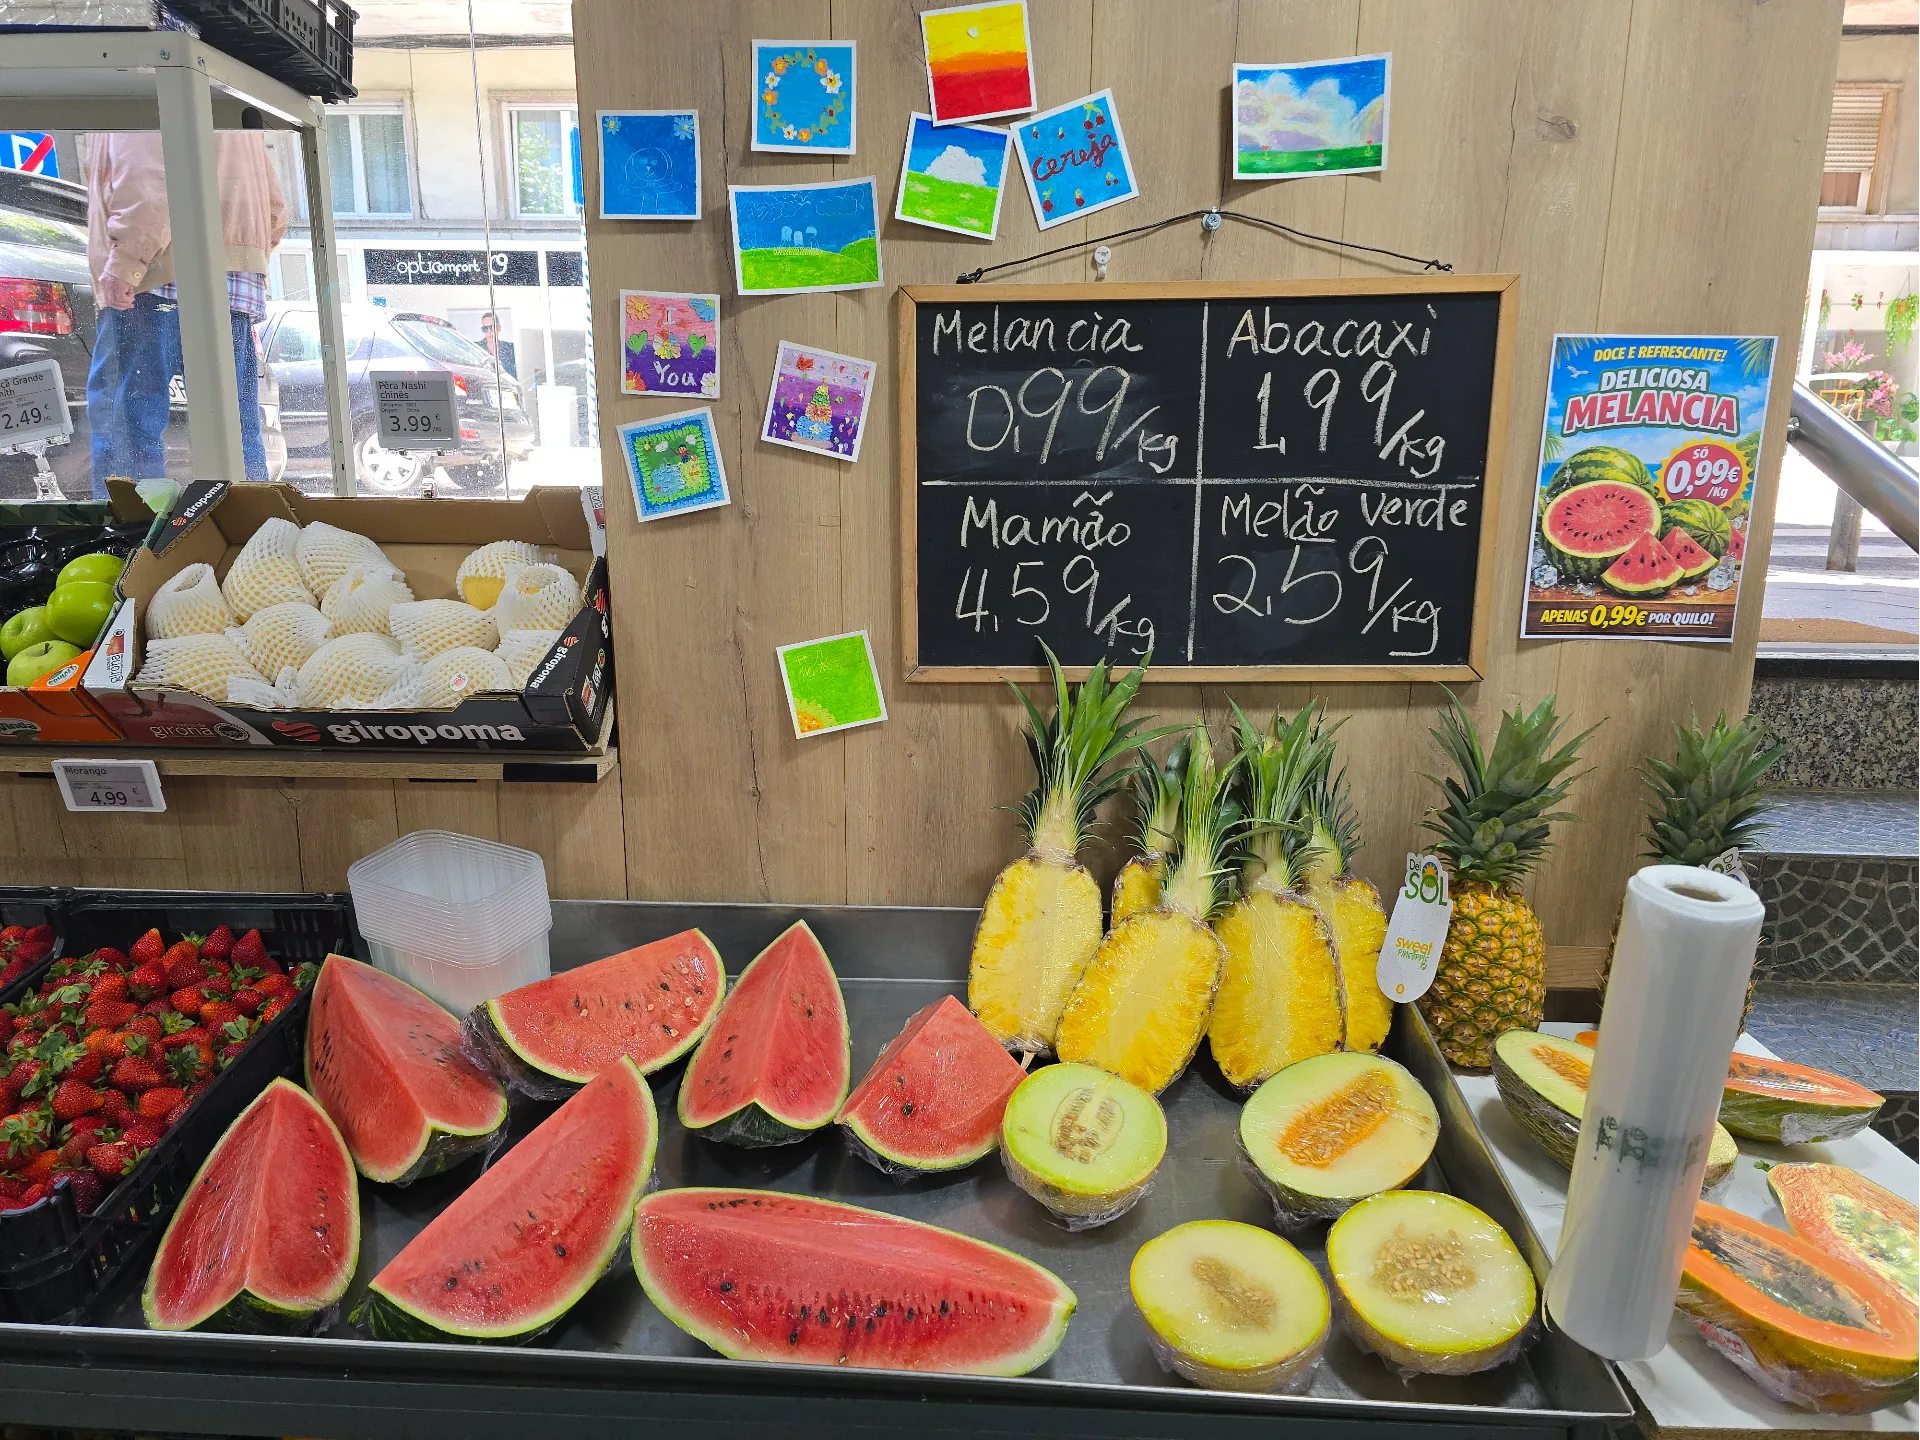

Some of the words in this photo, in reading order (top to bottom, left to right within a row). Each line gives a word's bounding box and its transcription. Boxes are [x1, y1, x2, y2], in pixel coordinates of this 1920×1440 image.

[662, 306, 677, 326] I
[932, 304, 1145, 356] Melancia
[1594, 349, 1625, 363] DOCE
[1628, 348, 1635, 359] E
[1637, 345, 1728, 362] REFRESCANTE!
[0, 379, 10, 391] çã
[13, 373, 44, 386] Grande
[653, 360, 697, 387] You
[1601, 368, 1707, 391] DELICIOSA
[379, 381, 399, 390] Pêra
[401, 381, 427, 390] Nashi
[380, 391, 409, 399] chinês
[2, 407, 42, 430] 2.49
[1565, 391, 1737, 432] MELANCIA
[389, 415, 432, 432] 3.99
[1666, 459, 1740, 497] 0,99€
[183, 482, 225, 518] giropoma
[1707, 486, 1728, 499] /Kg
[960, 490, 1132, 550] Mamão
[1540, 609, 1588, 624] APENAS
[1589, 605, 1648, 628] 0,99€
[1648, 612, 1671, 624] POR
[1672, 612, 1714, 625] QUILO!
[529, 646, 569, 690] giropoma
[326, 719, 527, 745] giropoma
[65, 767, 107, 777] Morango
[90, 791, 127, 805] 4.99
[1409, 858, 1422, 871] Del
[1404, 871, 1448, 906] SOL
[1395, 937, 1433, 955] sweet
